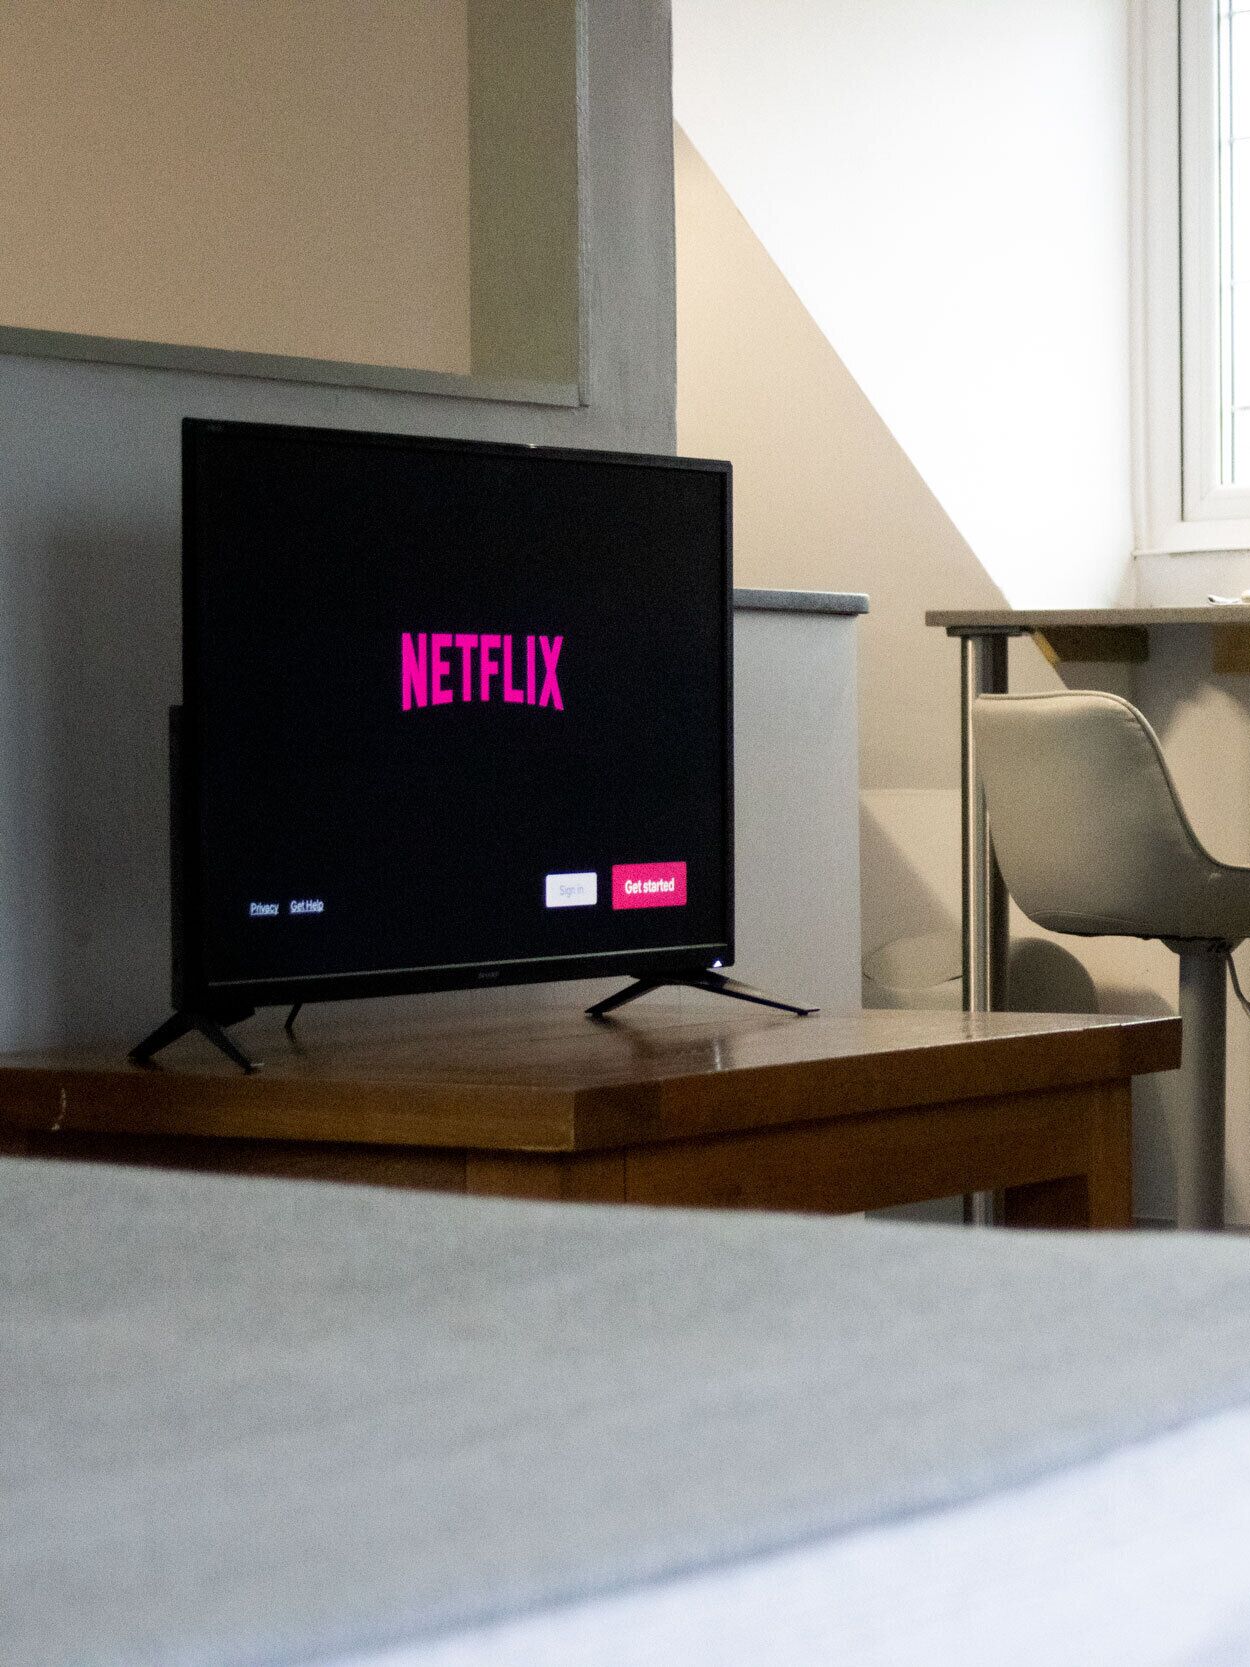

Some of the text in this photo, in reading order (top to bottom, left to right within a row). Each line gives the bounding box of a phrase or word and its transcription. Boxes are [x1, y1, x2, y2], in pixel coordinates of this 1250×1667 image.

[402, 632, 564, 712] NETFLIX
[560, 884, 576, 898] Sign
[624, 877, 675, 894] Get started
[250, 902, 279, 915] Privacy
[290, 899, 324, 913] Get Help
